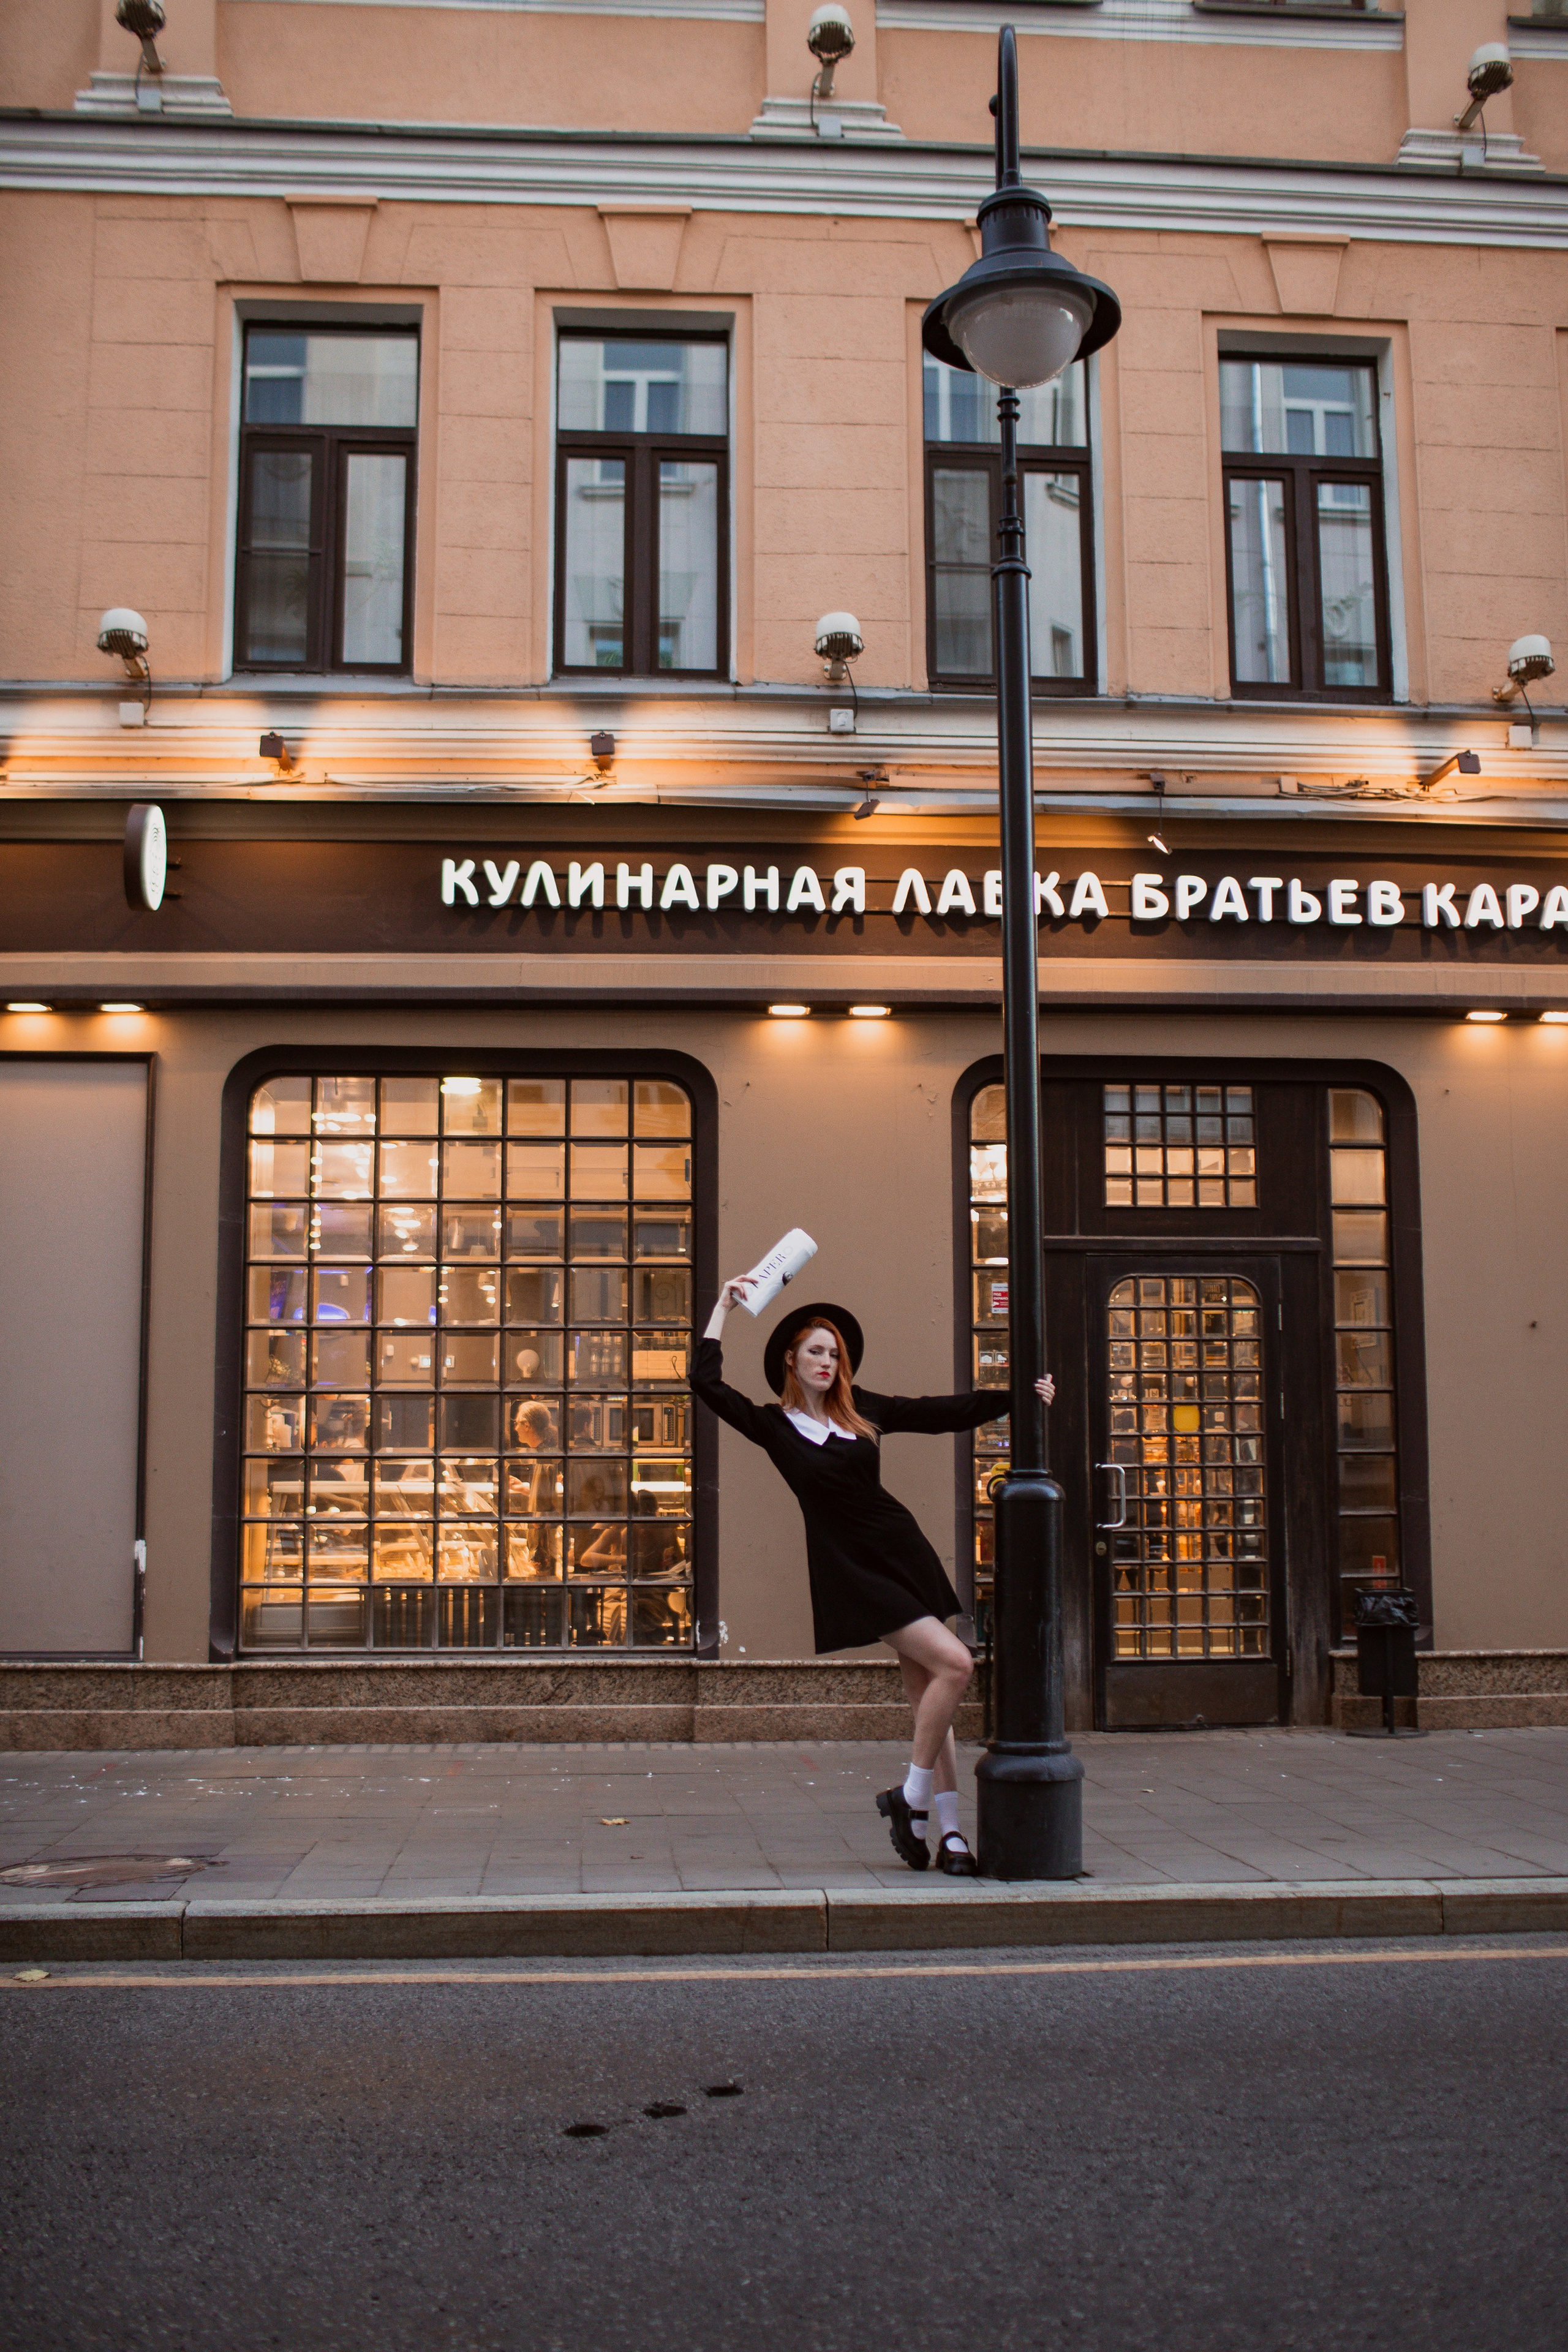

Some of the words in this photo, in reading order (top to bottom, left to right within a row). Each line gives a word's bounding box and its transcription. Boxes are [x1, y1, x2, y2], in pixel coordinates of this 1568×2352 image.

[442, 859, 865, 913] КУЛИНАРНАЯ
[1131, 874, 1405, 927] БРАТЬЕВ
[1423, 883, 1568, 930] КАРА
